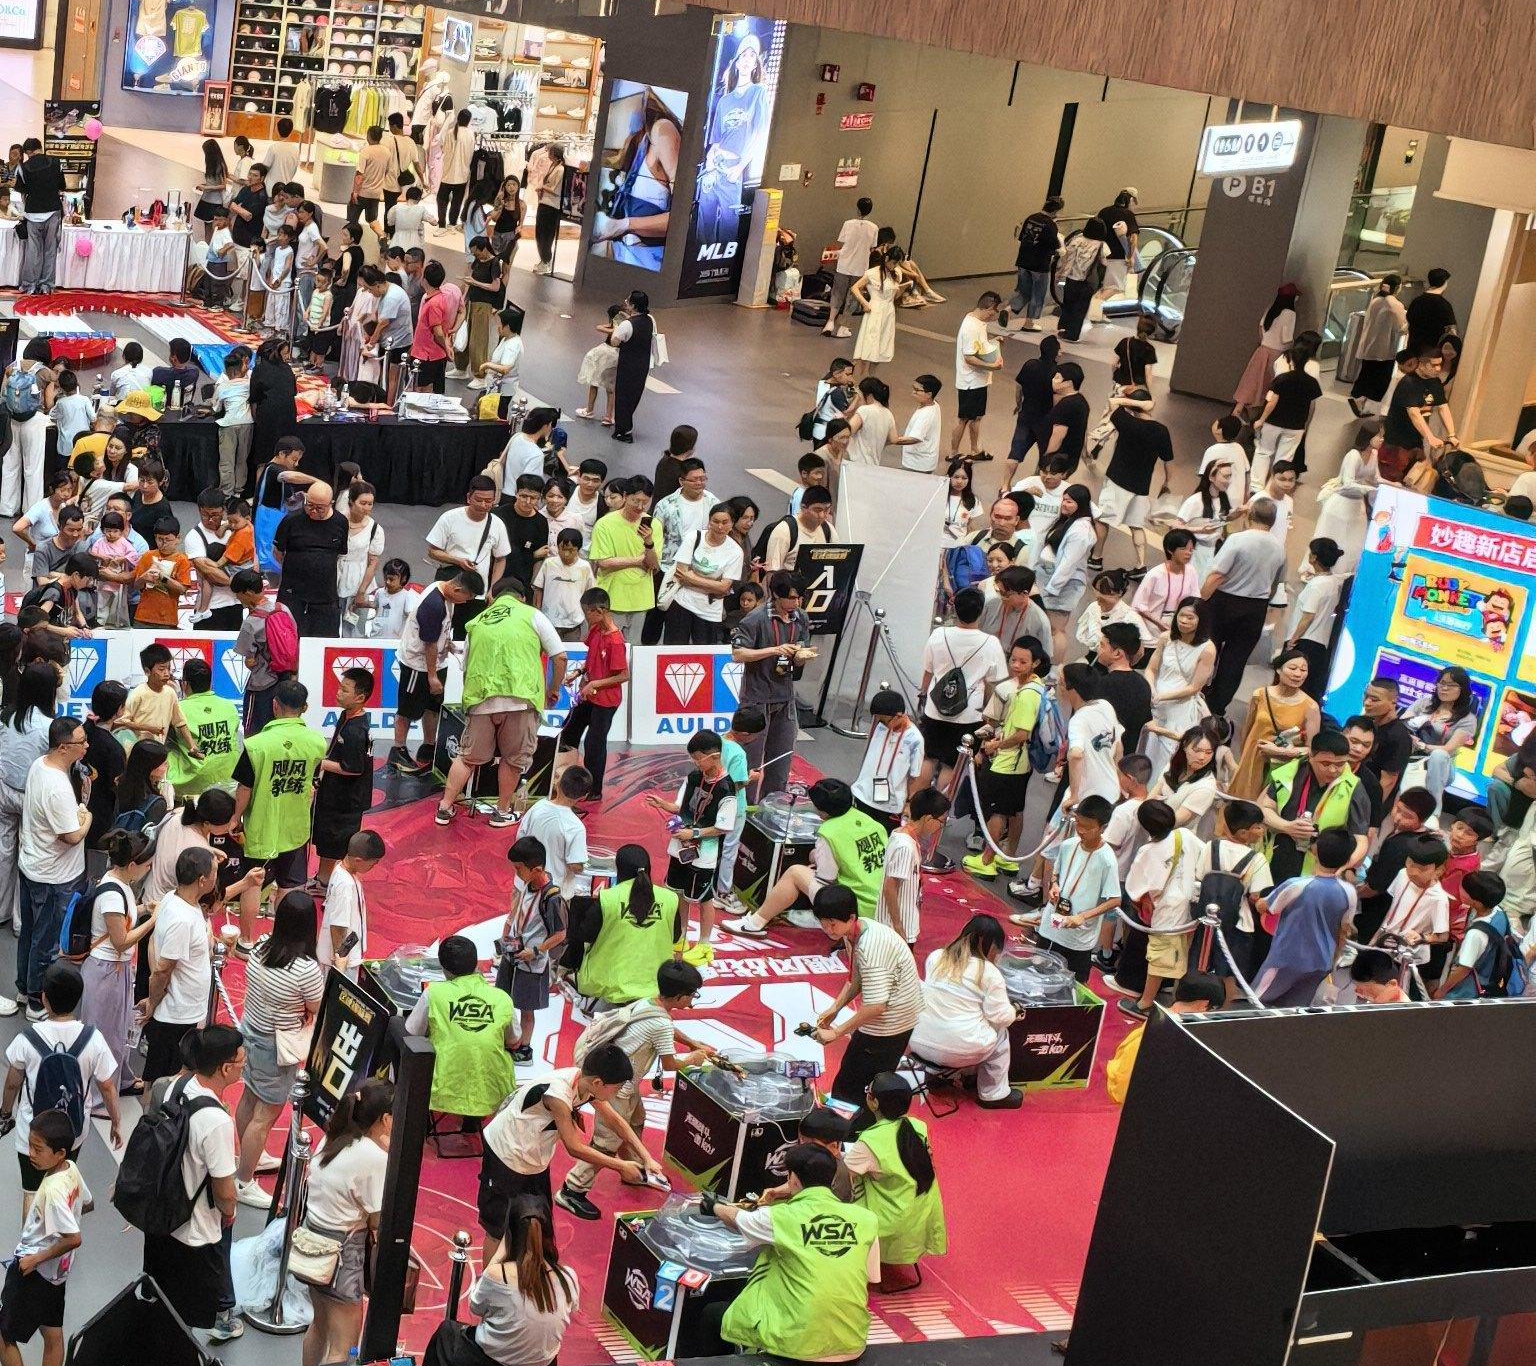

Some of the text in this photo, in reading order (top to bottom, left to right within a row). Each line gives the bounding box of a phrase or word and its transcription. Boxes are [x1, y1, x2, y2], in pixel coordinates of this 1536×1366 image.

[1252, 177, 1276, 197] B1
[697, 242, 739, 262] MLB
[807, 565, 837, 613] 入口
[449, 1001, 495, 1023] WSA
[801, 1223, 858, 1246] WSA
[657, 1284, 675, 1312] 2
